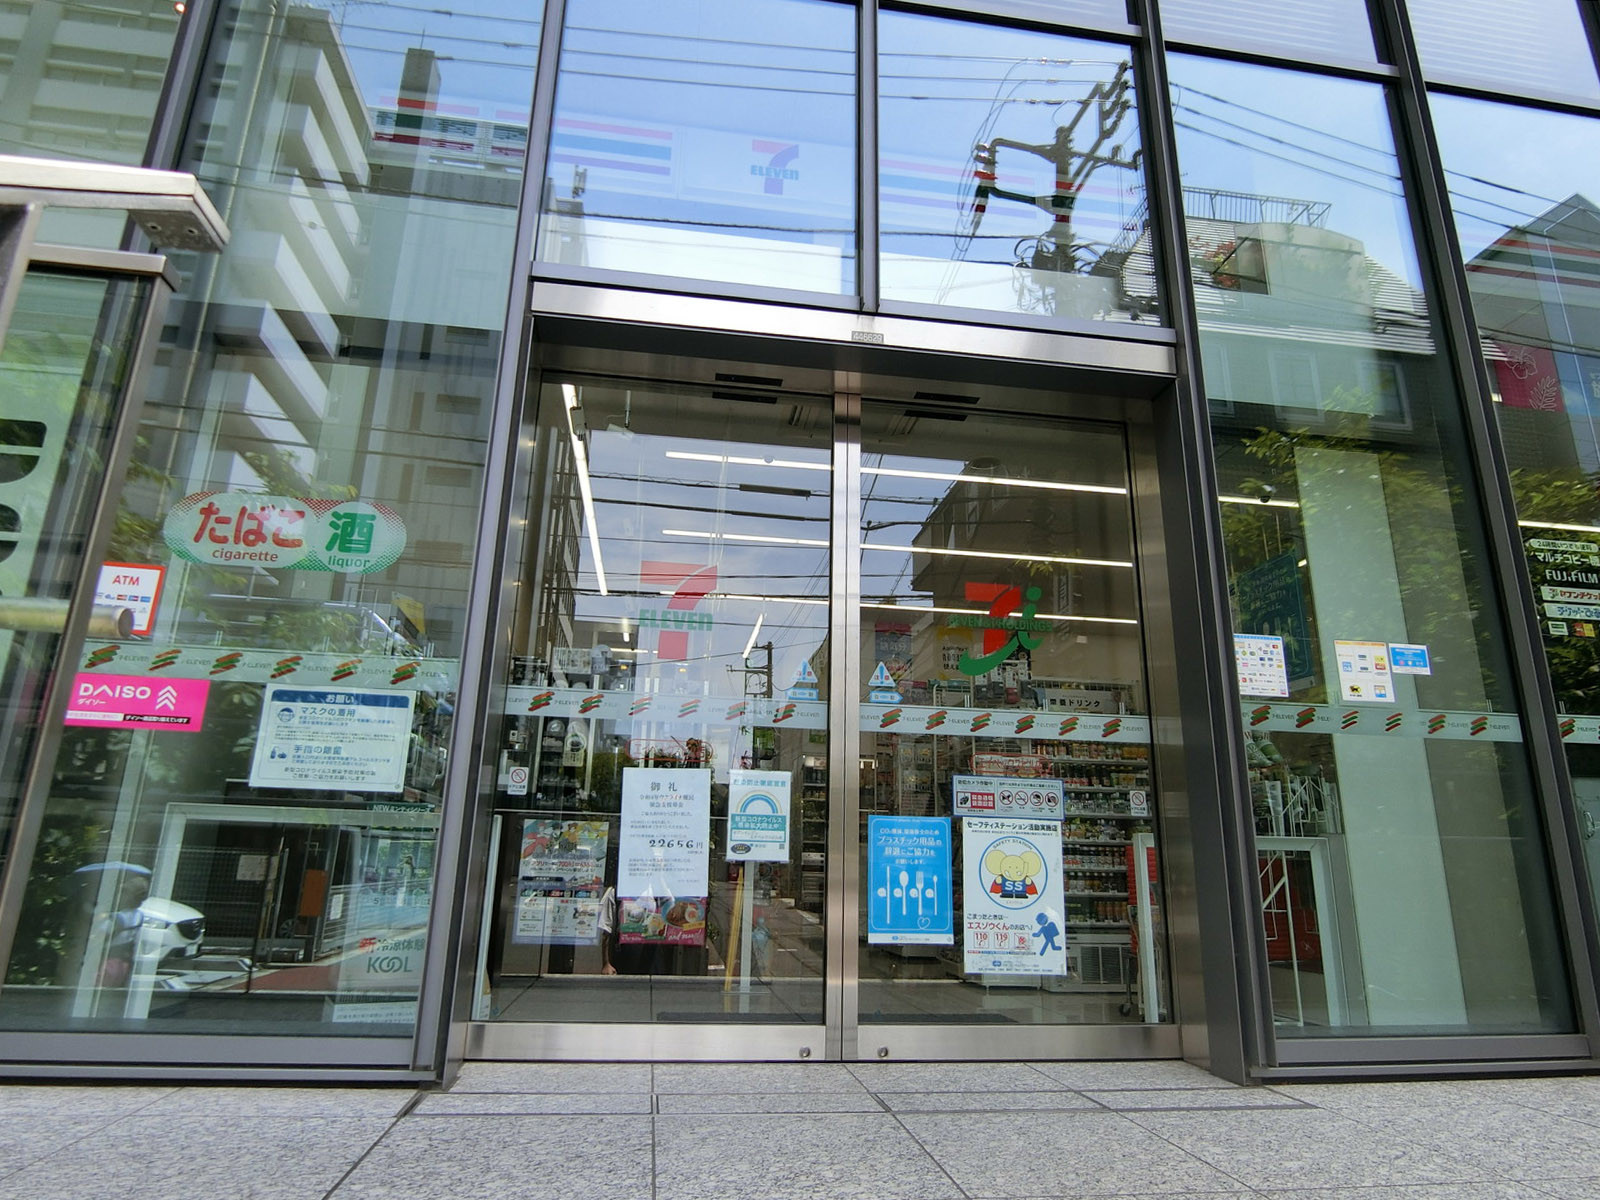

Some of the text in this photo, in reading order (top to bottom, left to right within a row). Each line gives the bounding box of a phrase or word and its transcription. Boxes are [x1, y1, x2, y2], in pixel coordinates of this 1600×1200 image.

[193, 501, 306, 548] たばこ
[325, 510, 377, 555] 酒
[212, 548, 278, 562] cigarette
[328, 555, 370, 568] liquor
[112, 575, 140, 587] ATM
[640, 560, 718, 661] 7
[79, 683, 151, 699] DAISO
[78, 698, 106, 706] ダイソー
[325, 694, 355, 704] お願い
[301, 707, 356, 718] マスクの着用
[373, 804, 389, 812] NEW
[967, 821, 1058, 832] セーフティステーション活動実施店
[649, 839, 694, 849] 22656
[878, 836, 942, 846] プラスチック用品の
[1005, 881, 1023, 891] SS
[995, 933, 1008, 941] 119
[366, 956, 413, 974] KOOL
